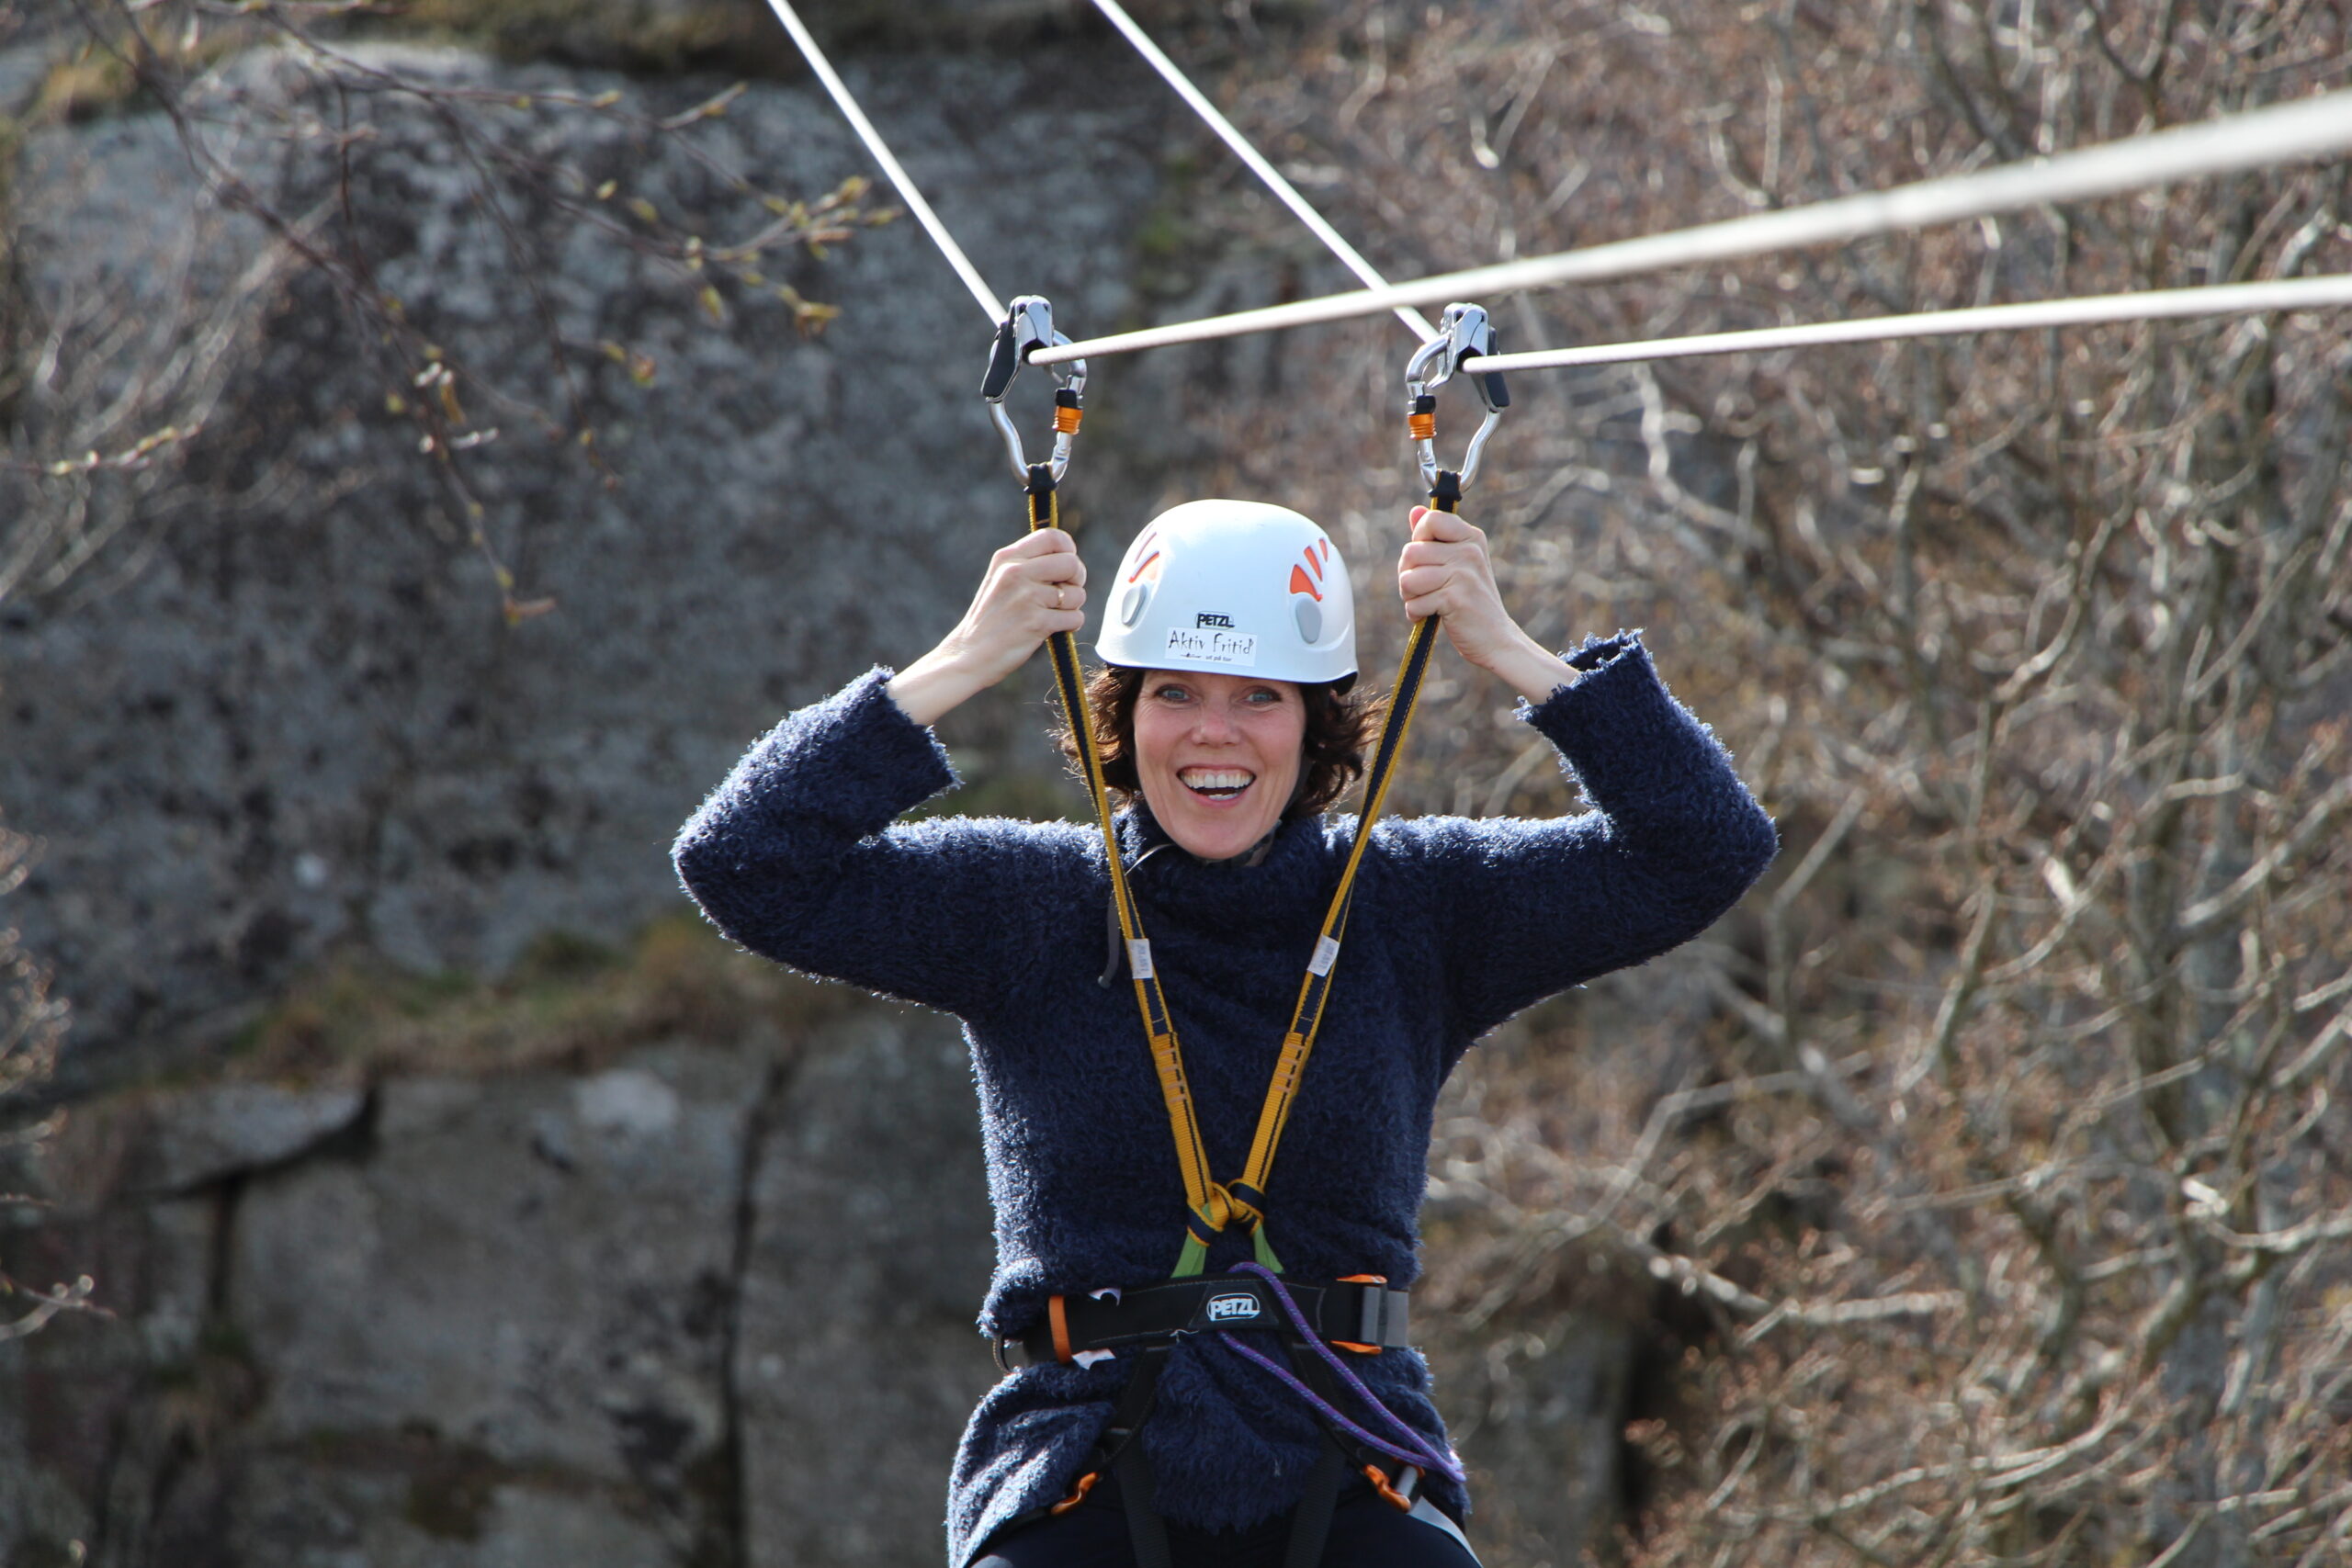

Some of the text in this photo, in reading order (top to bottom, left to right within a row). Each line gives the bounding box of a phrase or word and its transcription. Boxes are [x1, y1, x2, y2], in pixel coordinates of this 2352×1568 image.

[1197, 613, 1236, 628] PETZL
[1168, 629, 1254, 655] Aktiv Fritid
[1210, 1298, 1261, 1321] PETZL
